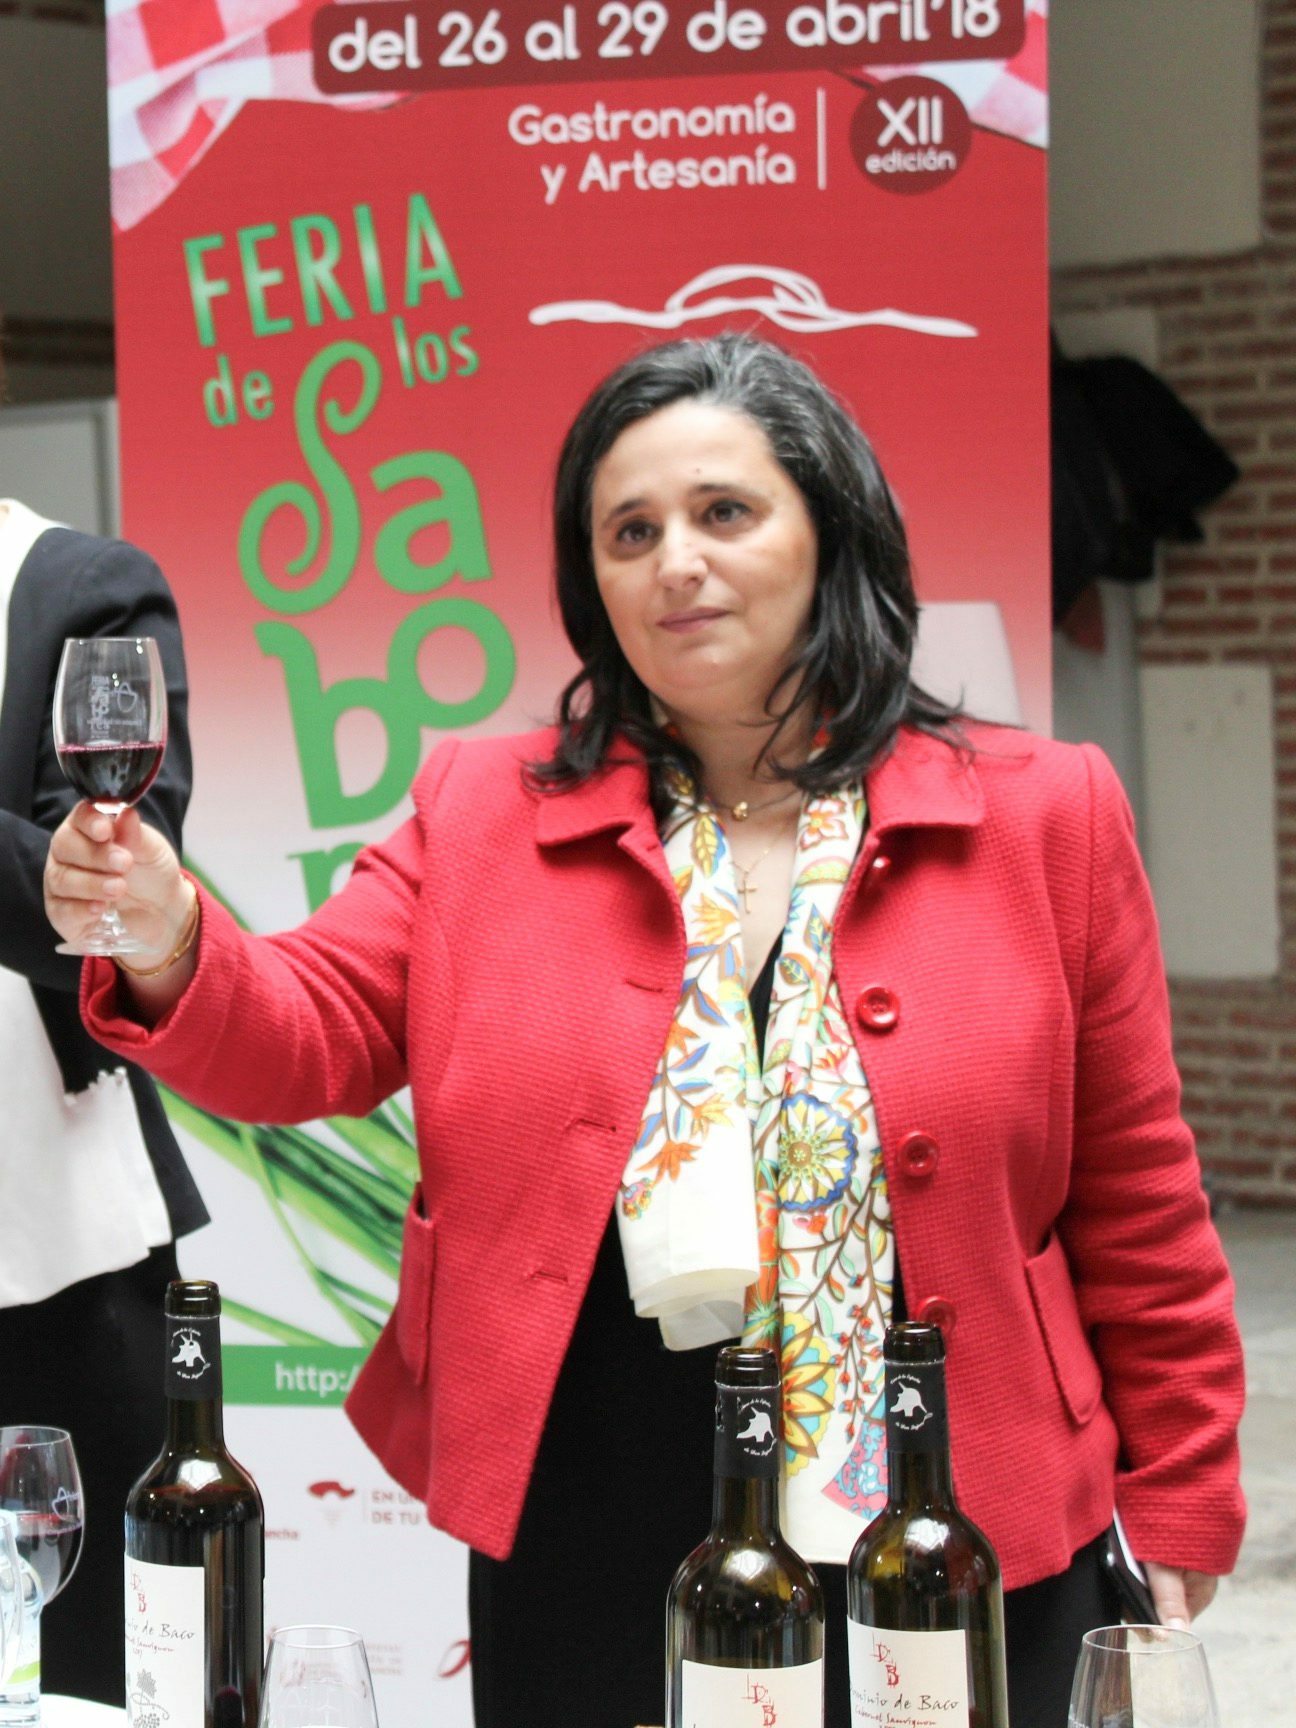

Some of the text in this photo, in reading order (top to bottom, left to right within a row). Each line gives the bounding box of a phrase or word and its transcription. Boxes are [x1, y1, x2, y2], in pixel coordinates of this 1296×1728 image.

[328, 14, 422, 72] del
[437, 9, 508, 67] 26
[524, 5, 581, 62] al
[597, 0, 669, 58] 29
[686, 0, 767, 52] de
[507, 92, 795, 145] Gastronomía
[877, 96, 943, 147] XII
[540, 144, 796, 205] y Artesanía
[865, 148, 957, 174] edición
[183, 193, 464, 348] FERIA
[392, 315, 480, 389] los
[203, 353, 274, 428] de
[265, 1529, 299, 1540] ancha
[893, 1693, 912, 1711] de
[918, 1694, 960, 1712] Baco
